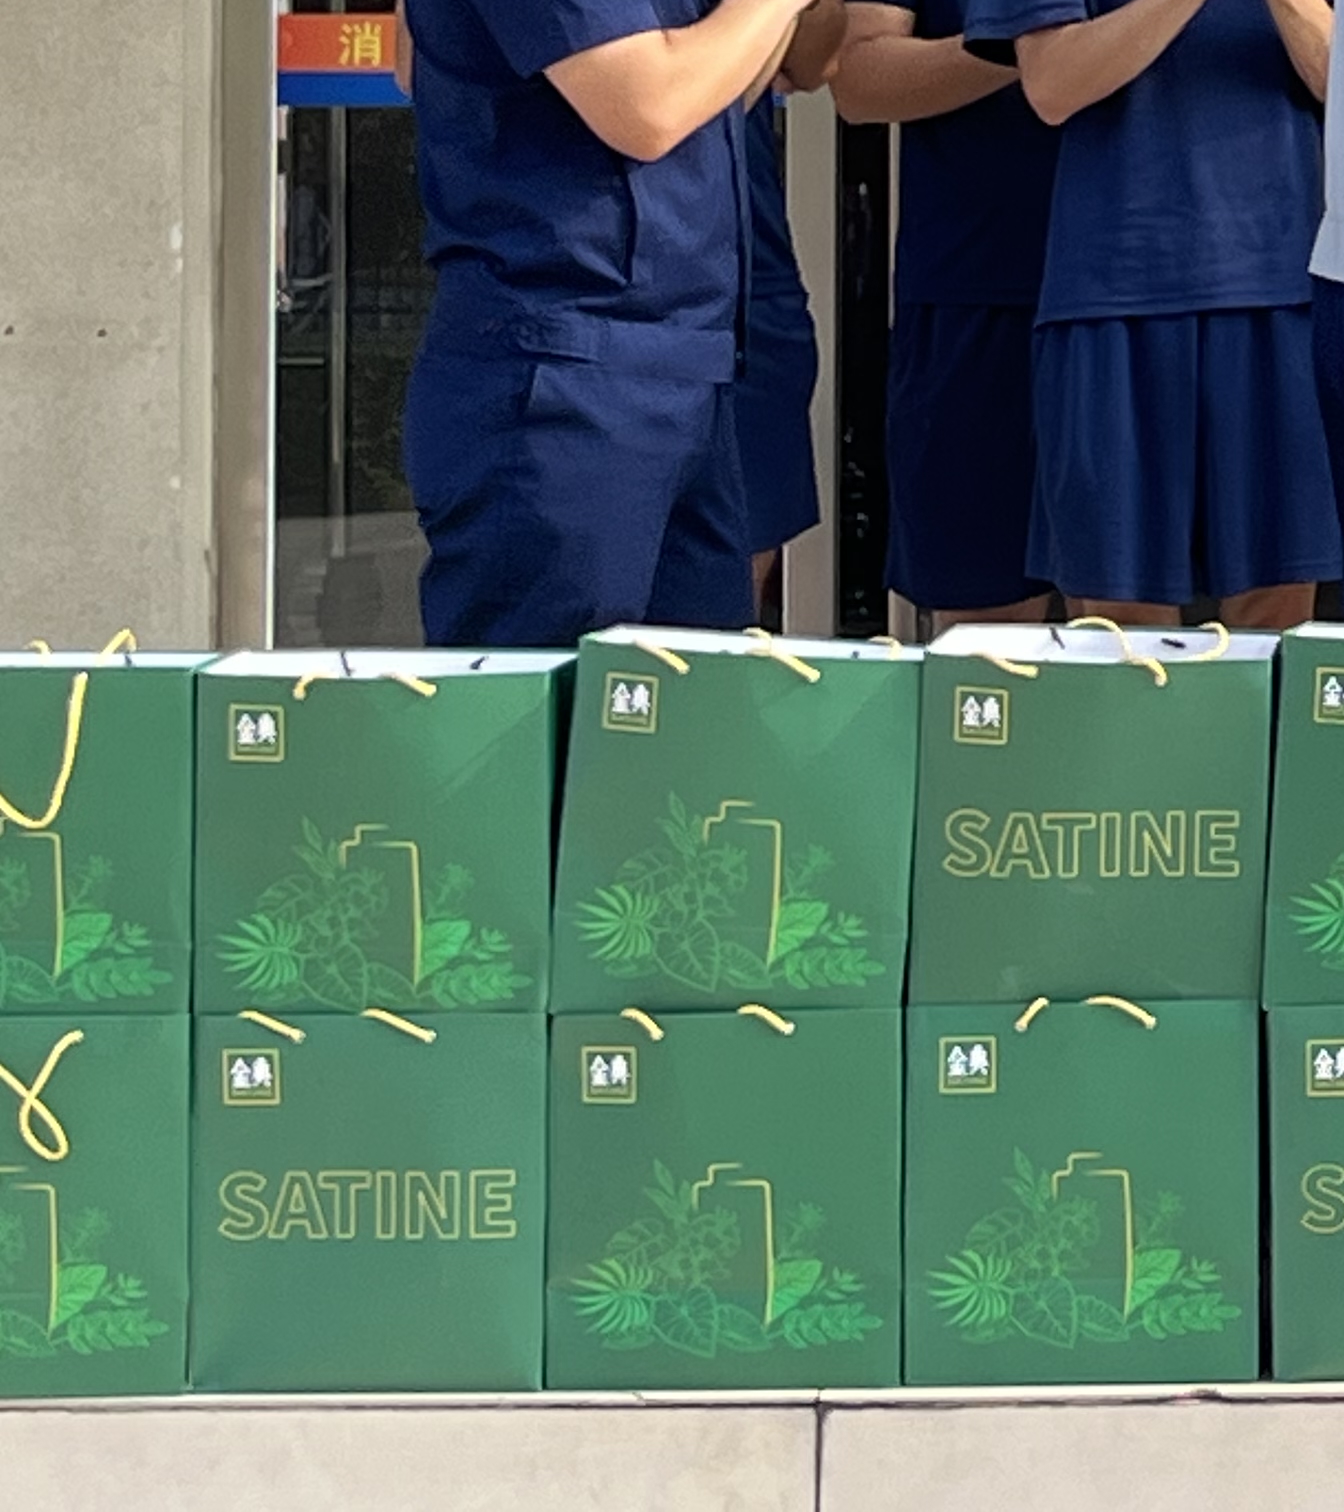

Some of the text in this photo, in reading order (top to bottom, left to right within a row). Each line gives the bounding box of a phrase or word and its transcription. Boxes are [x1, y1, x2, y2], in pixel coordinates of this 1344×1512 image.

[339, 21, 382, 67] 消
[943, 808, 1240, 879] SATINE
[218, 1169, 518, 1240] SATINE
